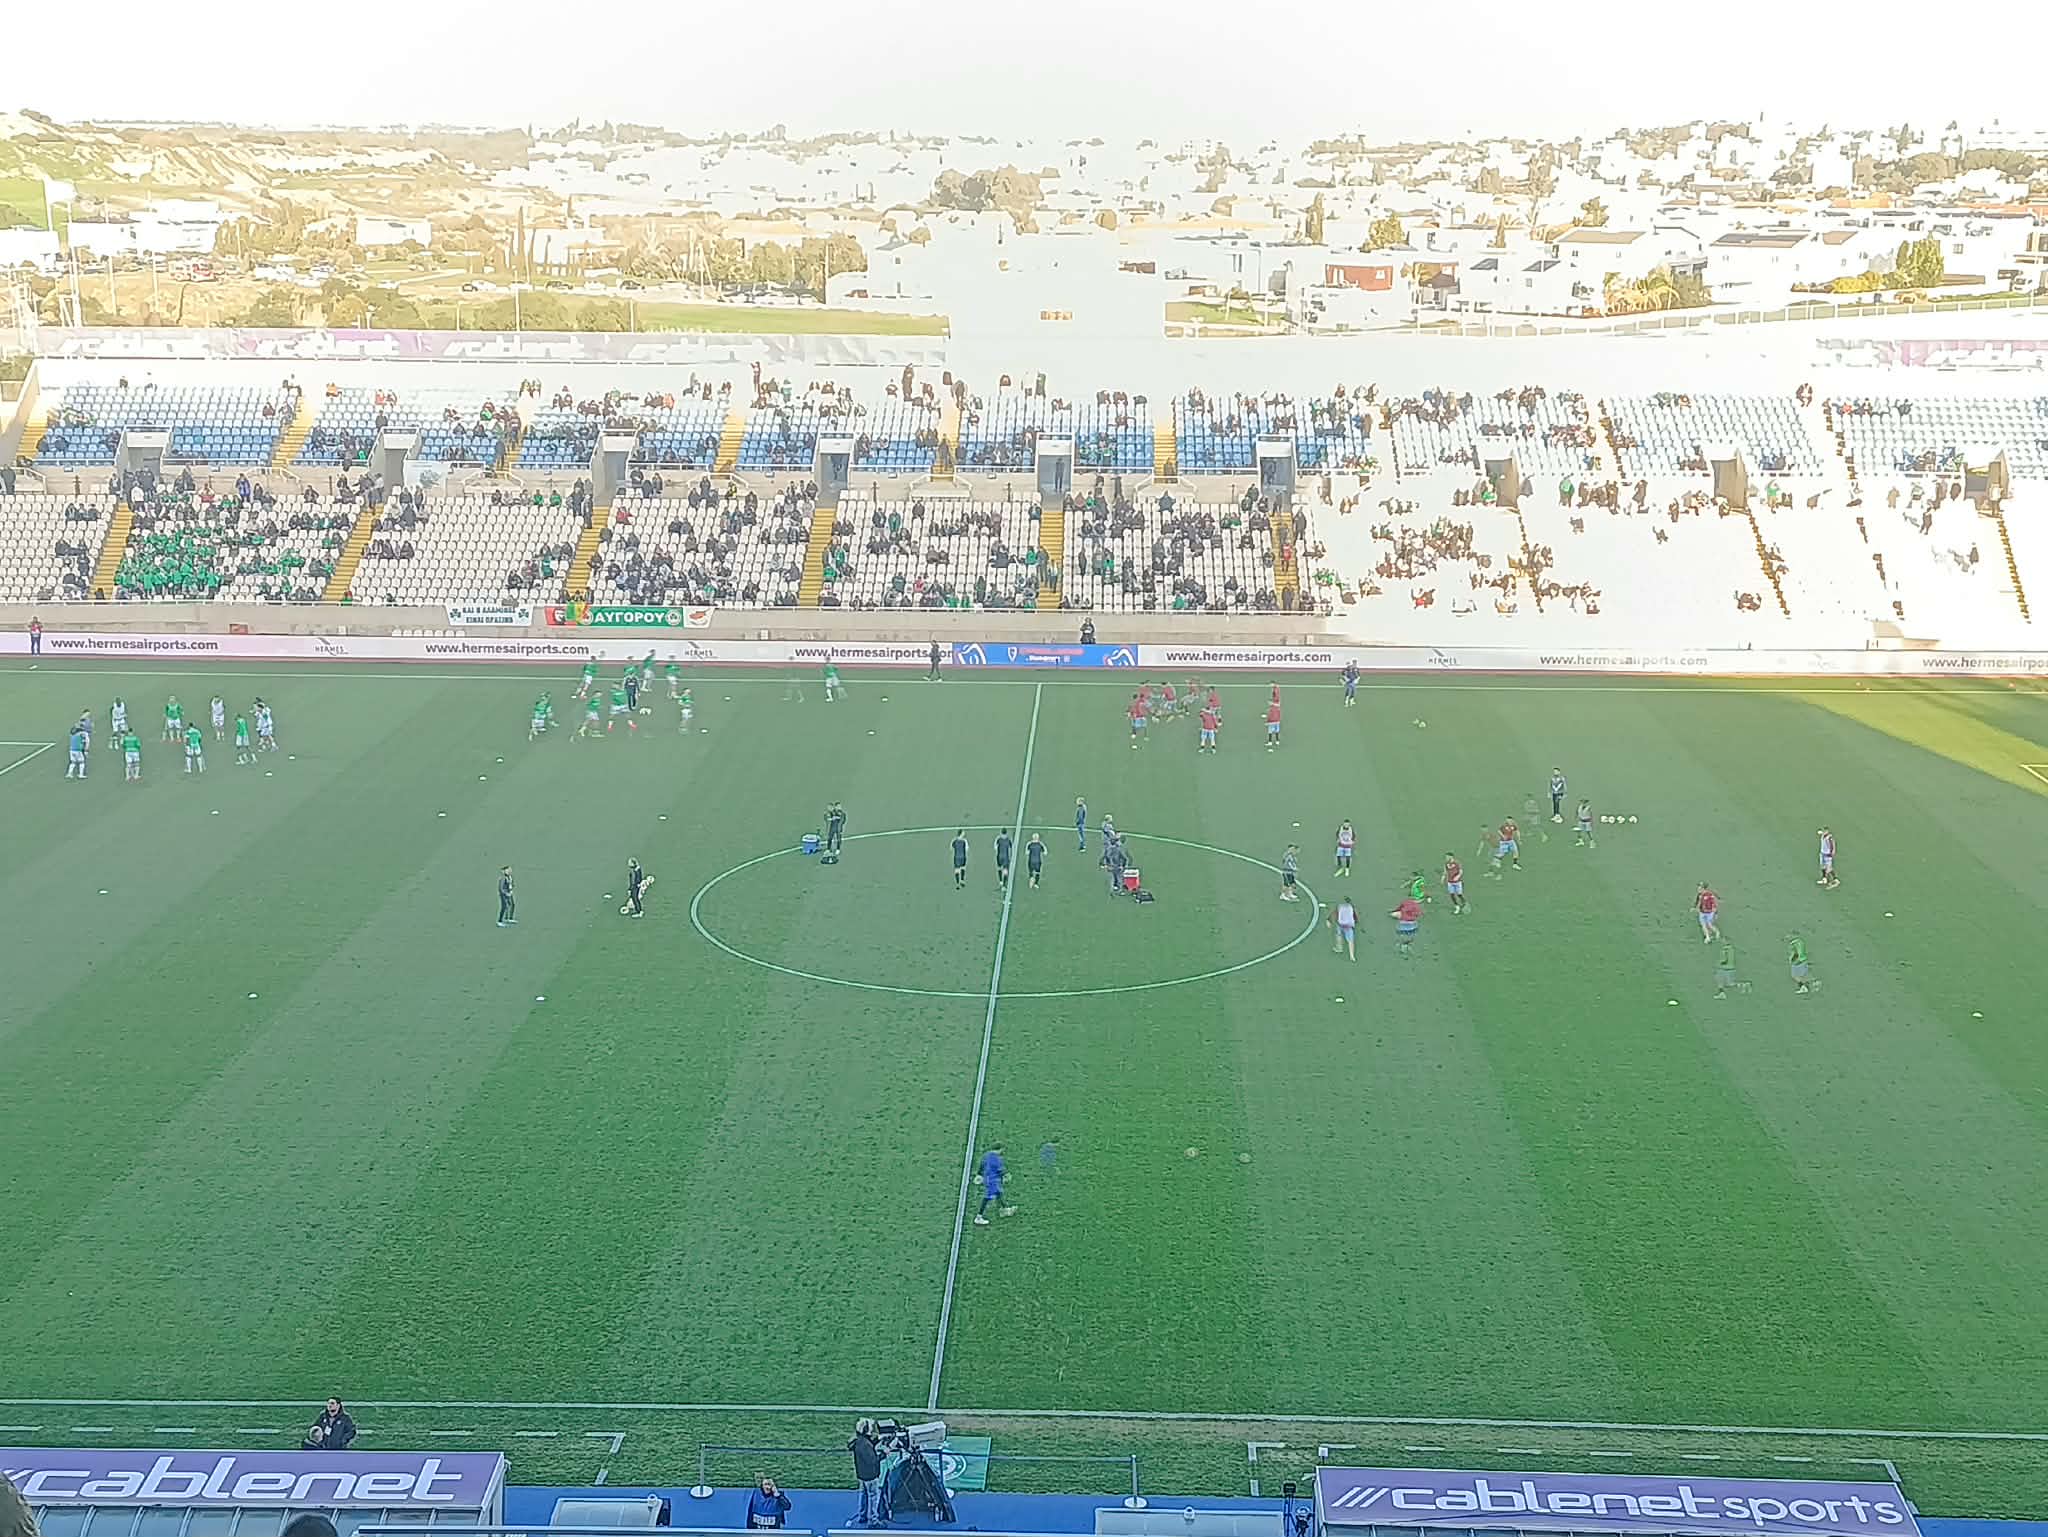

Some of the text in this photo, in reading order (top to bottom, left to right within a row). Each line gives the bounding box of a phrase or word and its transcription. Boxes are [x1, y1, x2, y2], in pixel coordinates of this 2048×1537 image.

[595, 611, 665, 624] ΑΥΓΟΡΟΥ
[50, 637, 219, 652] www.hermesairports.com
[425, 642, 590, 656] www.hermesairports.com
[1166, 650, 1332, 665] www.hermesairports.com
[1922, 656, 2048, 671] www.hermesairpo
[22, 1456, 463, 1500] cablenet
